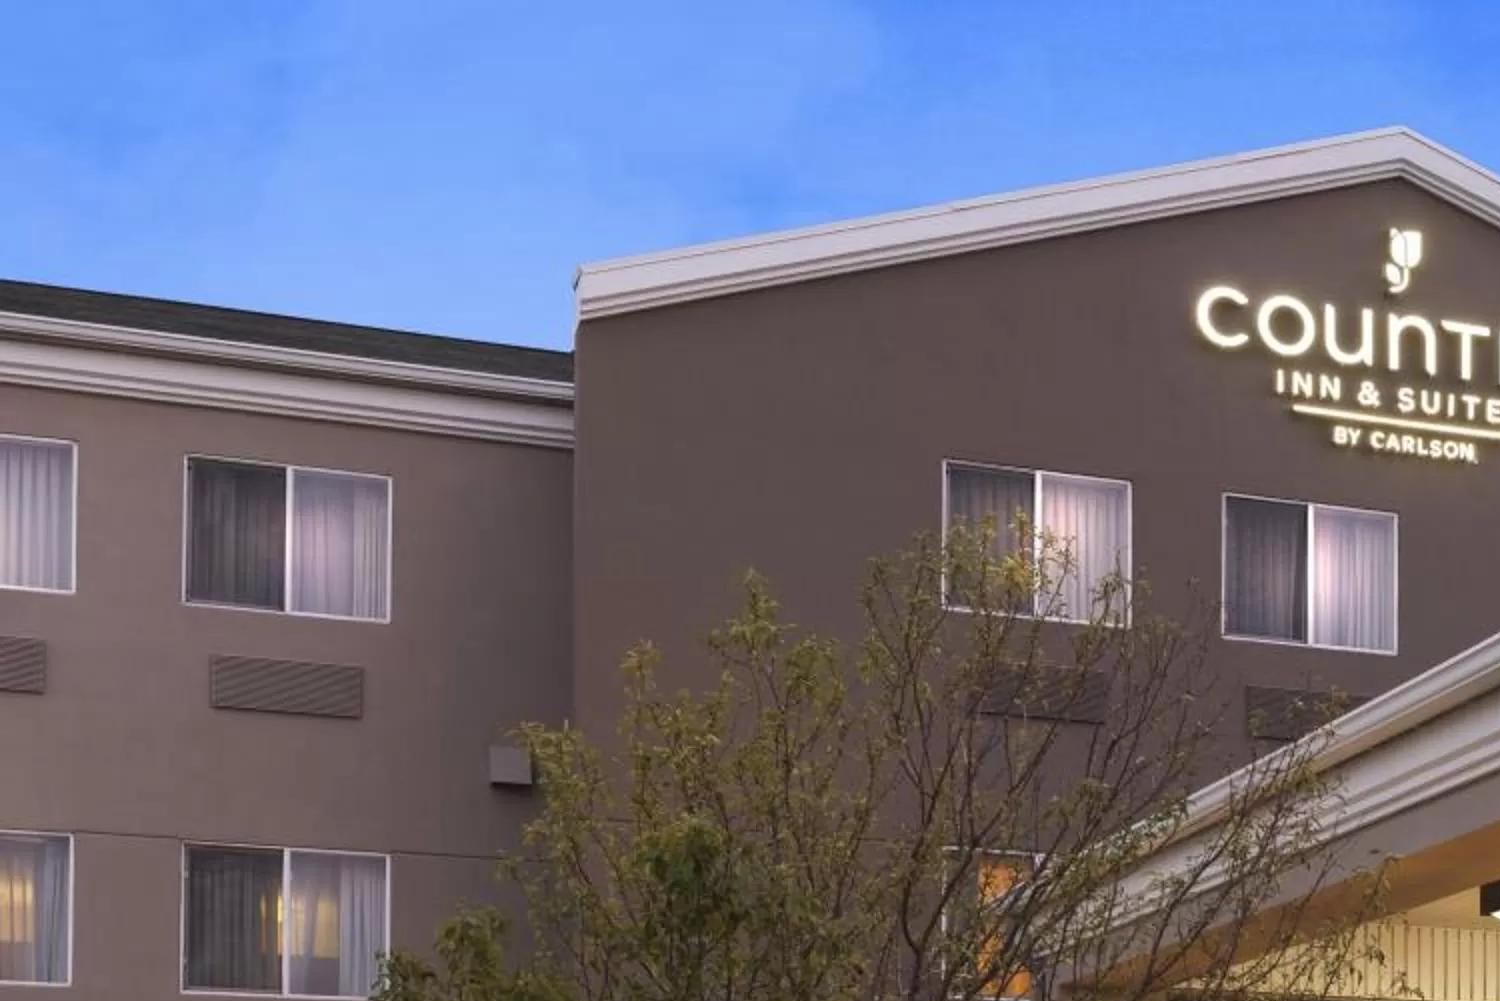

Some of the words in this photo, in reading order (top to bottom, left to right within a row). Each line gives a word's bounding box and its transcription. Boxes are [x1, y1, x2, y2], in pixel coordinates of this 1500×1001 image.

[1275, 368, 1342, 401] INN
[1357, 380, 1380, 408] &
[1333, 425, 1361, 446] BY
[1370, 430, 1475, 462] CARLSON
